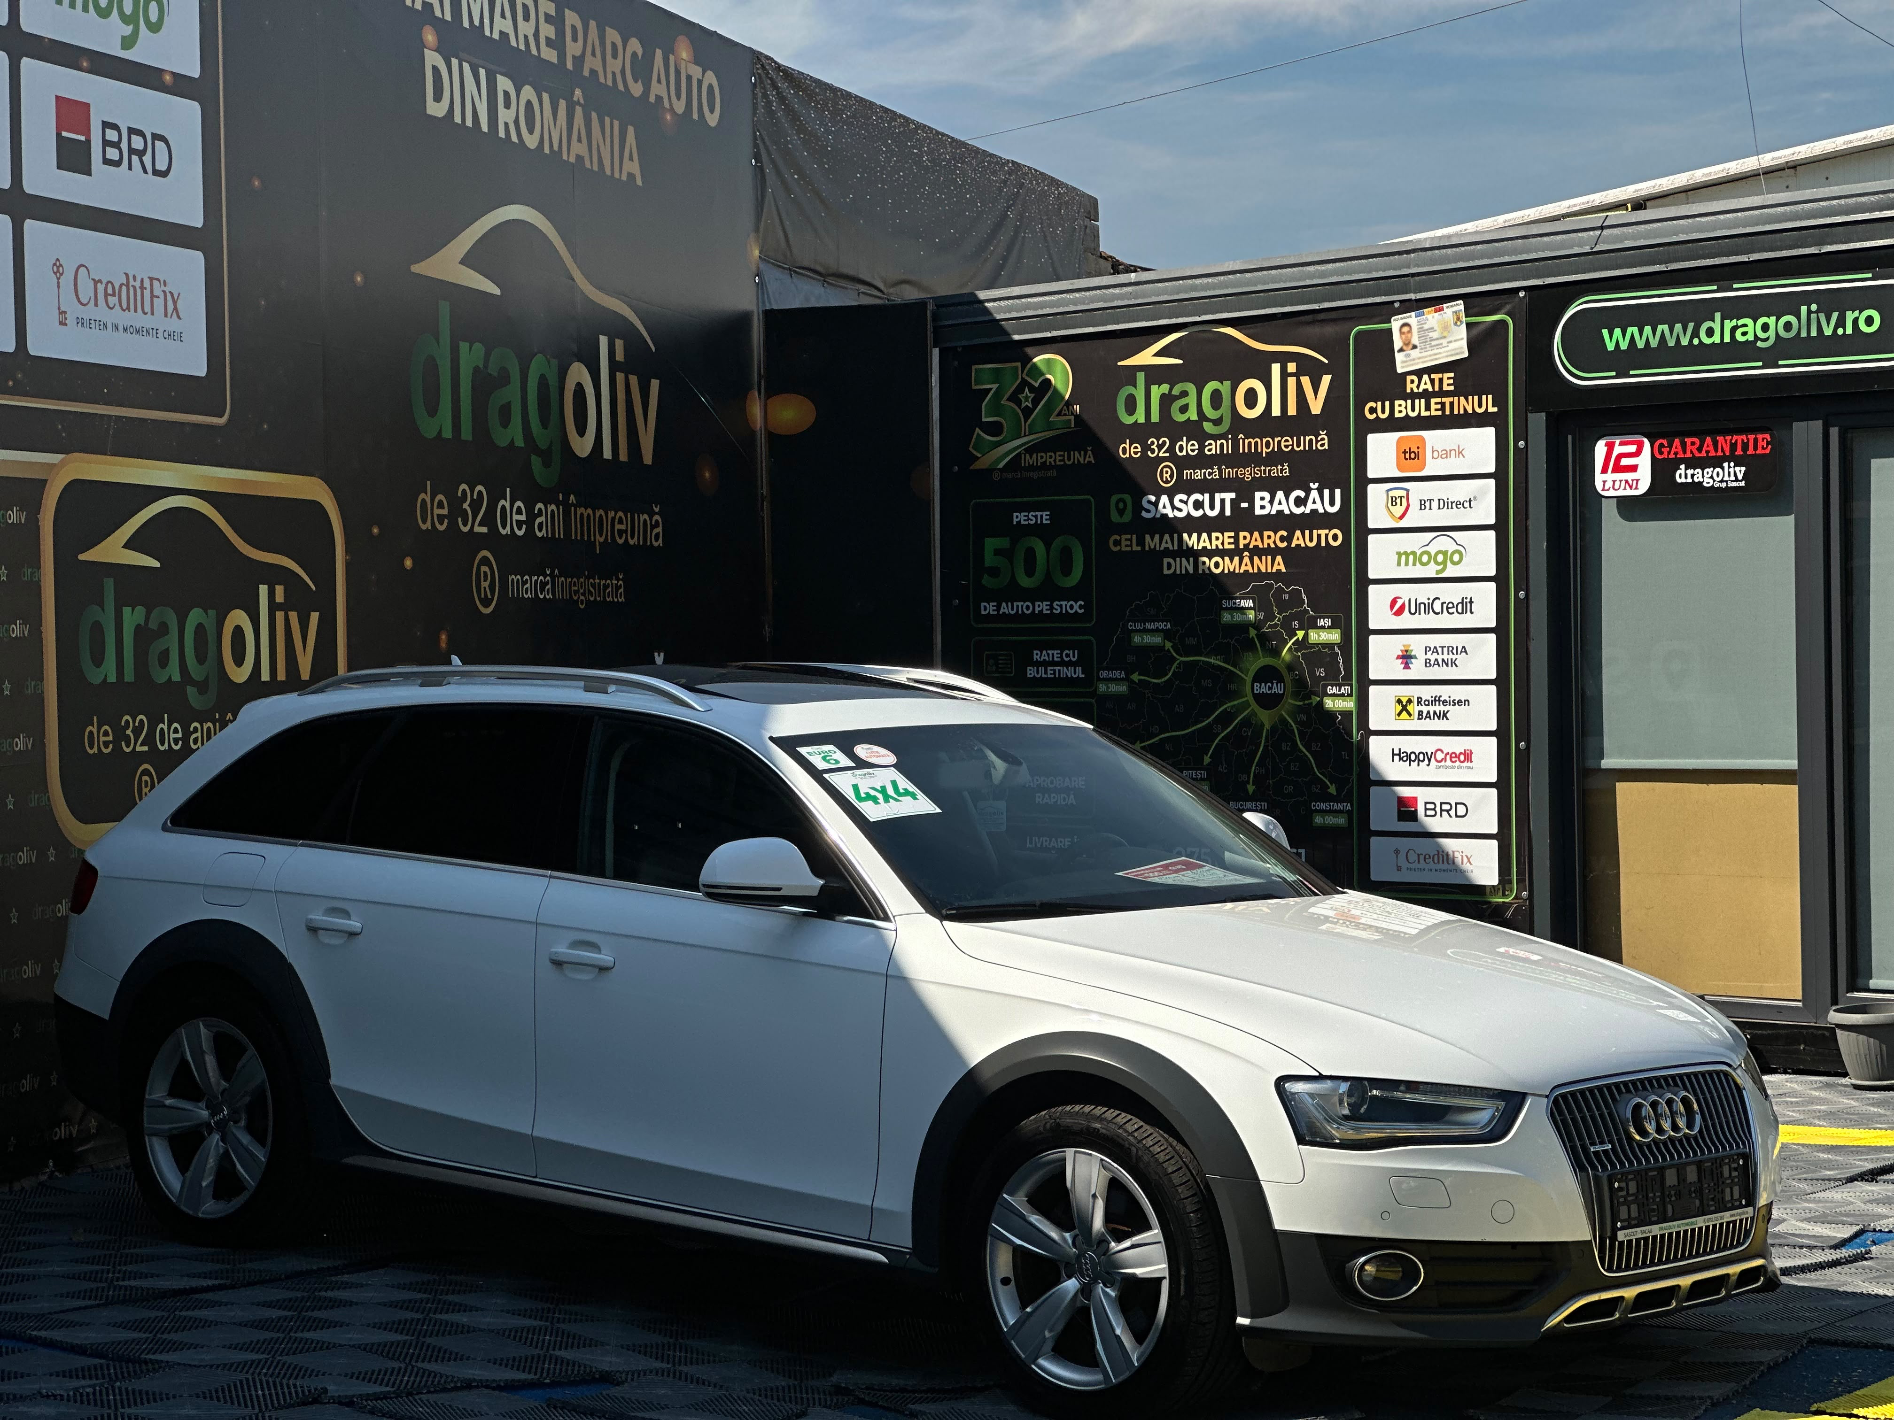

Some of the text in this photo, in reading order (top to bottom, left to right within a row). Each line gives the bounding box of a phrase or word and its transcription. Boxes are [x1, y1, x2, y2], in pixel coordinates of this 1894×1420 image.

[55, 0, 165, 50] go
[564, 8, 643, 98] PARC
[649, 48, 721, 128] AUTO
[423, 48, 642, 186] DIN ROMÂNIA
[101, 120, 173, 179] BRD
[73, 263, 182, 320] CreditFix
[75, 317, 184, 342] PRIETEN IN MOMENTE CHEIE
[1602, 303, 1880, 351] www.dragoliv.ro
[1406, 373, 1455, 393] RATE
[410, 300, 660, 488] dragoliv
[1116, 362, 1332, 434] dragoliv
[969, 353, 1074, 458] 32
[1364, 395, 1498, 420] CU BULETINUL
[1119, 430, 1329, 458] de 32 de ani împreună
[1402, 445, 1465, 461] tbi bank
[1653, 433, 1771, 460] GARANTIE
[1021, 446, 1095, 467] ÎMPREUNĂ
[1600, 439, 1644, 474] 12
[1183, 465, 1219, 480] marcă
[1221, 463, 1290, 481] înregistrată
[1675, 462, 1746, 487] dragoliv
[1601, 478, 1640, 492] LUNI
[1141, 492, 1236, 518] SASCUT
[1254, 482, 1341, 516] BACĂU
[1390, 495, 1405, 507] BT
[1419, 498, 1435, 511] BT
[416, 481, 663, 554] de 32 de ani împreună
[1012, 511, 1051, 525] PESTE
[1109, 529, 1343, 551] CEL MAI MARE PARC AUTO
[981, 534, 1085, 589] 500
[1163, 552, 1286, 574] DIN ROMÂNIA
[1396, 548, 1464, 575] mogo
[508, 567, 552, 600] marcă
[555, 569, 625, 609] înregistrată
[981, 600, 1085, 615] DE AUTO PE STOC
[1222, 599, 1254, 608] SUCEAVA
[1408, 596, 1474, 615] UniCredit
[1127, 621, 1171, 630] CLUJ-NAPOCA
[79, 578, 320, 711] dragoliv
[1310, 632, 1339, 640] 1h 30min
[1033, 650, 1078, 662] RATE CU
[1424, 646, 1468, 656] PATRIA
[1027, 666, 1085, 678] BULETINUL
[1424, 658, 1459, 668] BANK
[1099, 670, 1125, 679] ORADEA
[1254, 680, 1284, 694] BACĂU
[1416, 695, 1470, 707] Raiffeisen
[1416, 710, 1451, 721] BANK
[84, 716, 112, 754] de
[121, 714, 149, 753] 32
[155, 713, 183, 751] de
[821, 754, 841, 766] 6
[1391, 747, 1473, 767] HappyCredit
[1424, 801, 1469, 818] BRD
[1314, 816, 1323, 824] 4h
[1405, 849, 1473, 866] CreditFix
